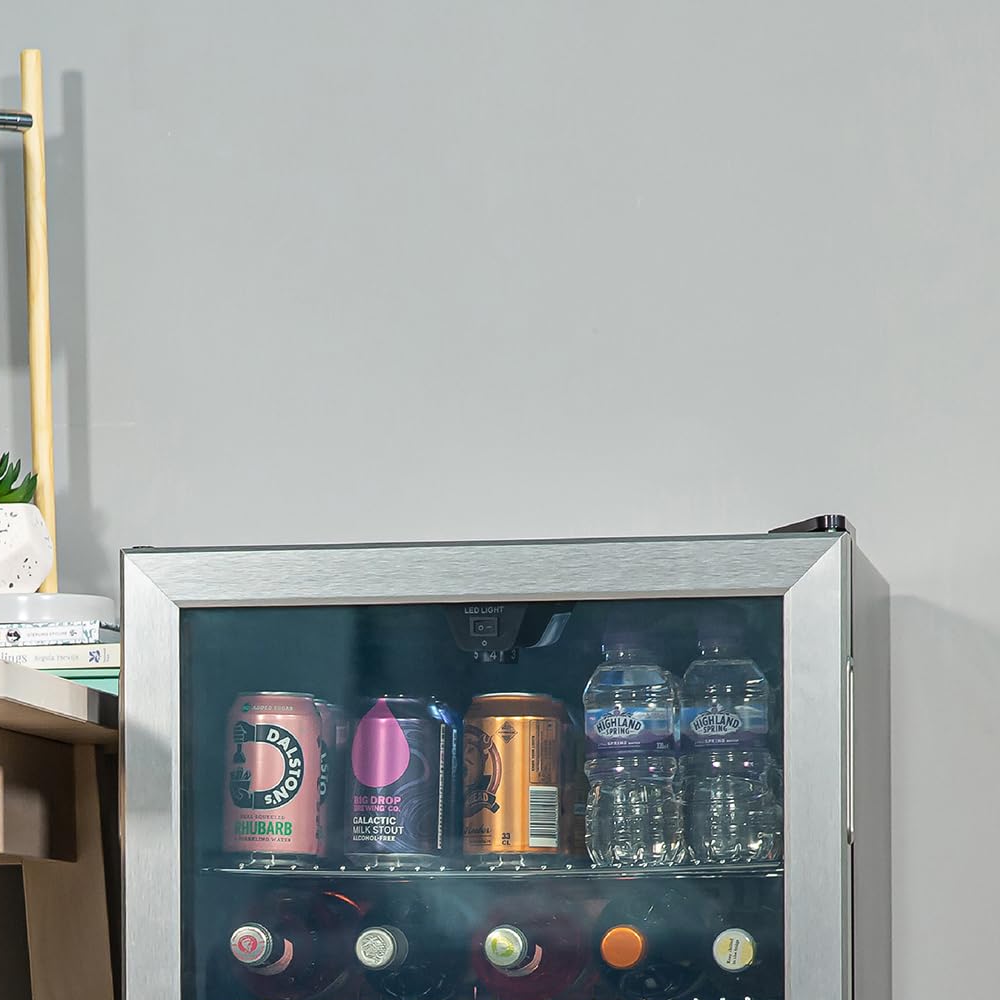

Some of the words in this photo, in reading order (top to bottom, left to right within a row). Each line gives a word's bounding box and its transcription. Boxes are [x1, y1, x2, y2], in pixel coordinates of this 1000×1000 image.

[481, 606, 504, 614] LIGHT
[596, 718, 642, 733] HIGHLAND
[693, 715, 740, 731] HIGHLAND
[606, 727, 630, 735] SPRING
[703, 725, 728, 733] SPRING
[353, 796, 368, 804] BIG
[370, 796, 401, 804] DROP
[353, 816, 396, 825] GALACTIC
[235, 821, 292, 836] RHUBARB
[353, 826, 371, 834] MILK
[372, 826, 404, 834] STOUT
